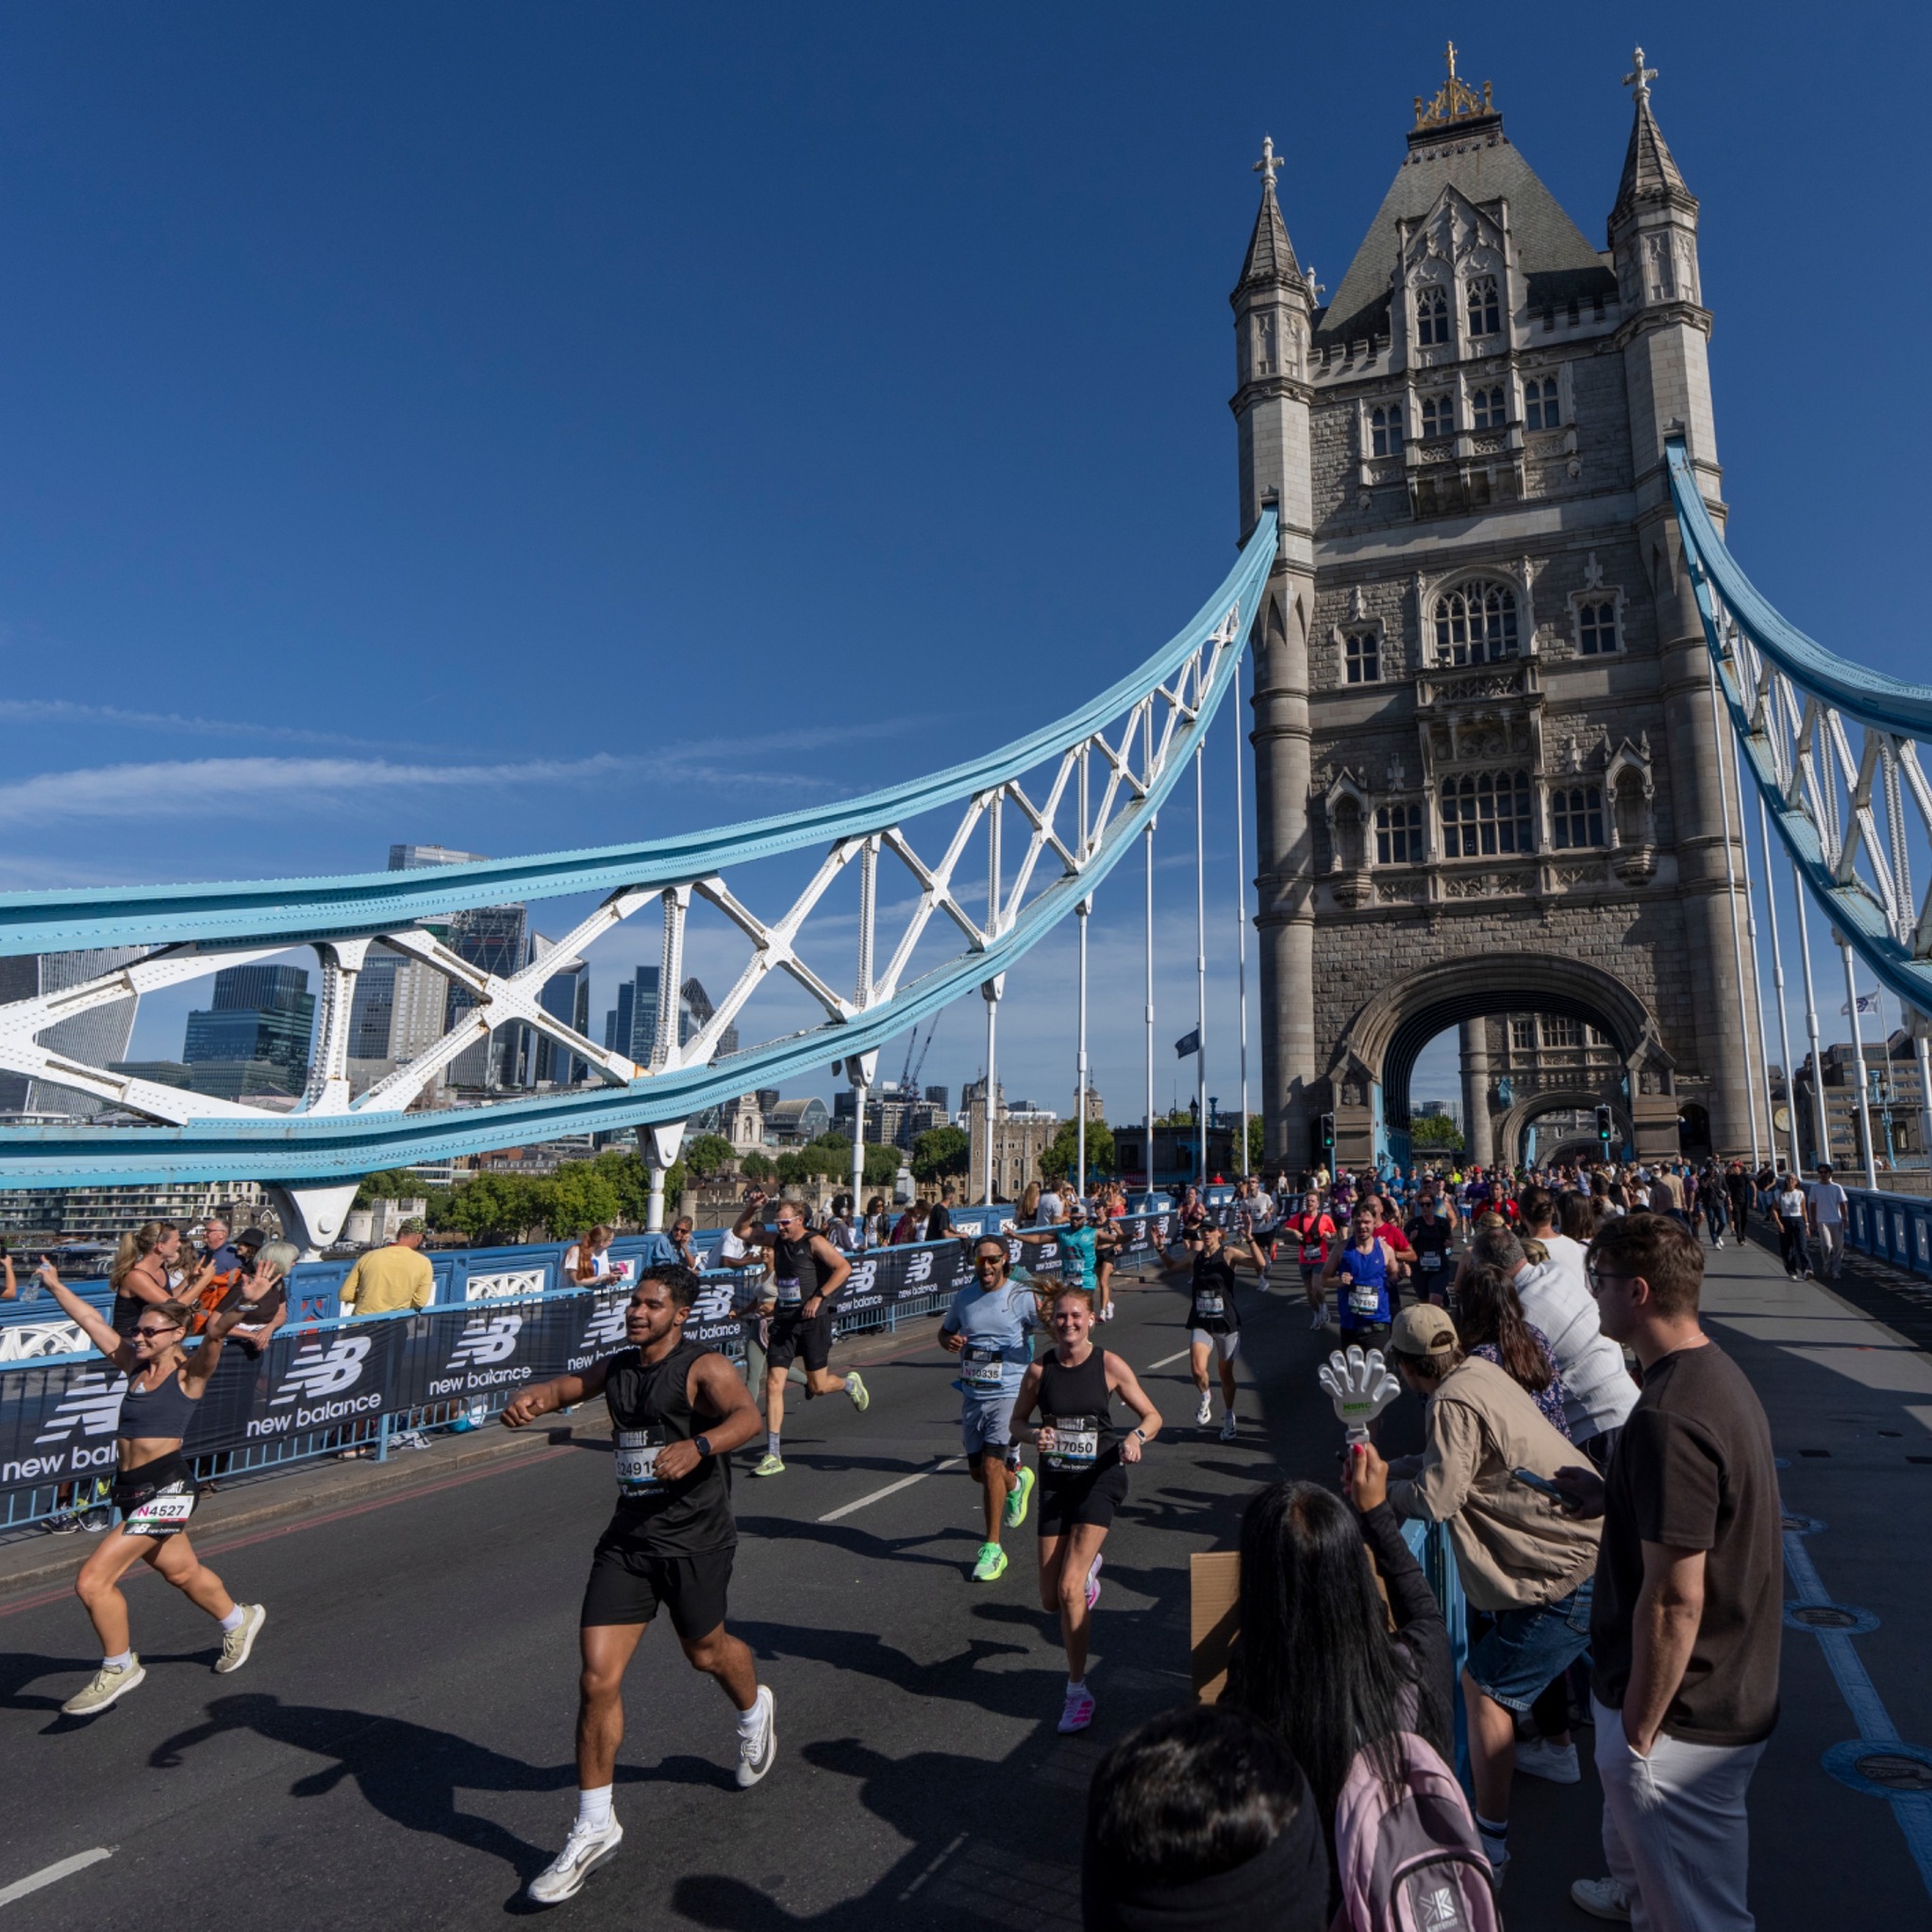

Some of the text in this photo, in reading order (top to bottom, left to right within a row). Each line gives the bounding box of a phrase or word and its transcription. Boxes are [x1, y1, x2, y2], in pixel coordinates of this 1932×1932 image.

[843, 1259, 878, 1296] NB
[904, 1251, 934, 1285] NB
[686, 1284, 735, 1324] NB
[837, 1293, 883, 1313] new balance
[445, 1314, 524, 1370] NB
[682, 1324, 741, 1341] ew balance
[269, 1336, 372, 1407] NB
[567, 1355, 594, 1371] new
[429, 1366, 532, 1395] new balance
[245, 1392, 382, 1437] new balance
[2, 1454, 66, 1482] new
[137, 1505, 185, 1518] N4527
